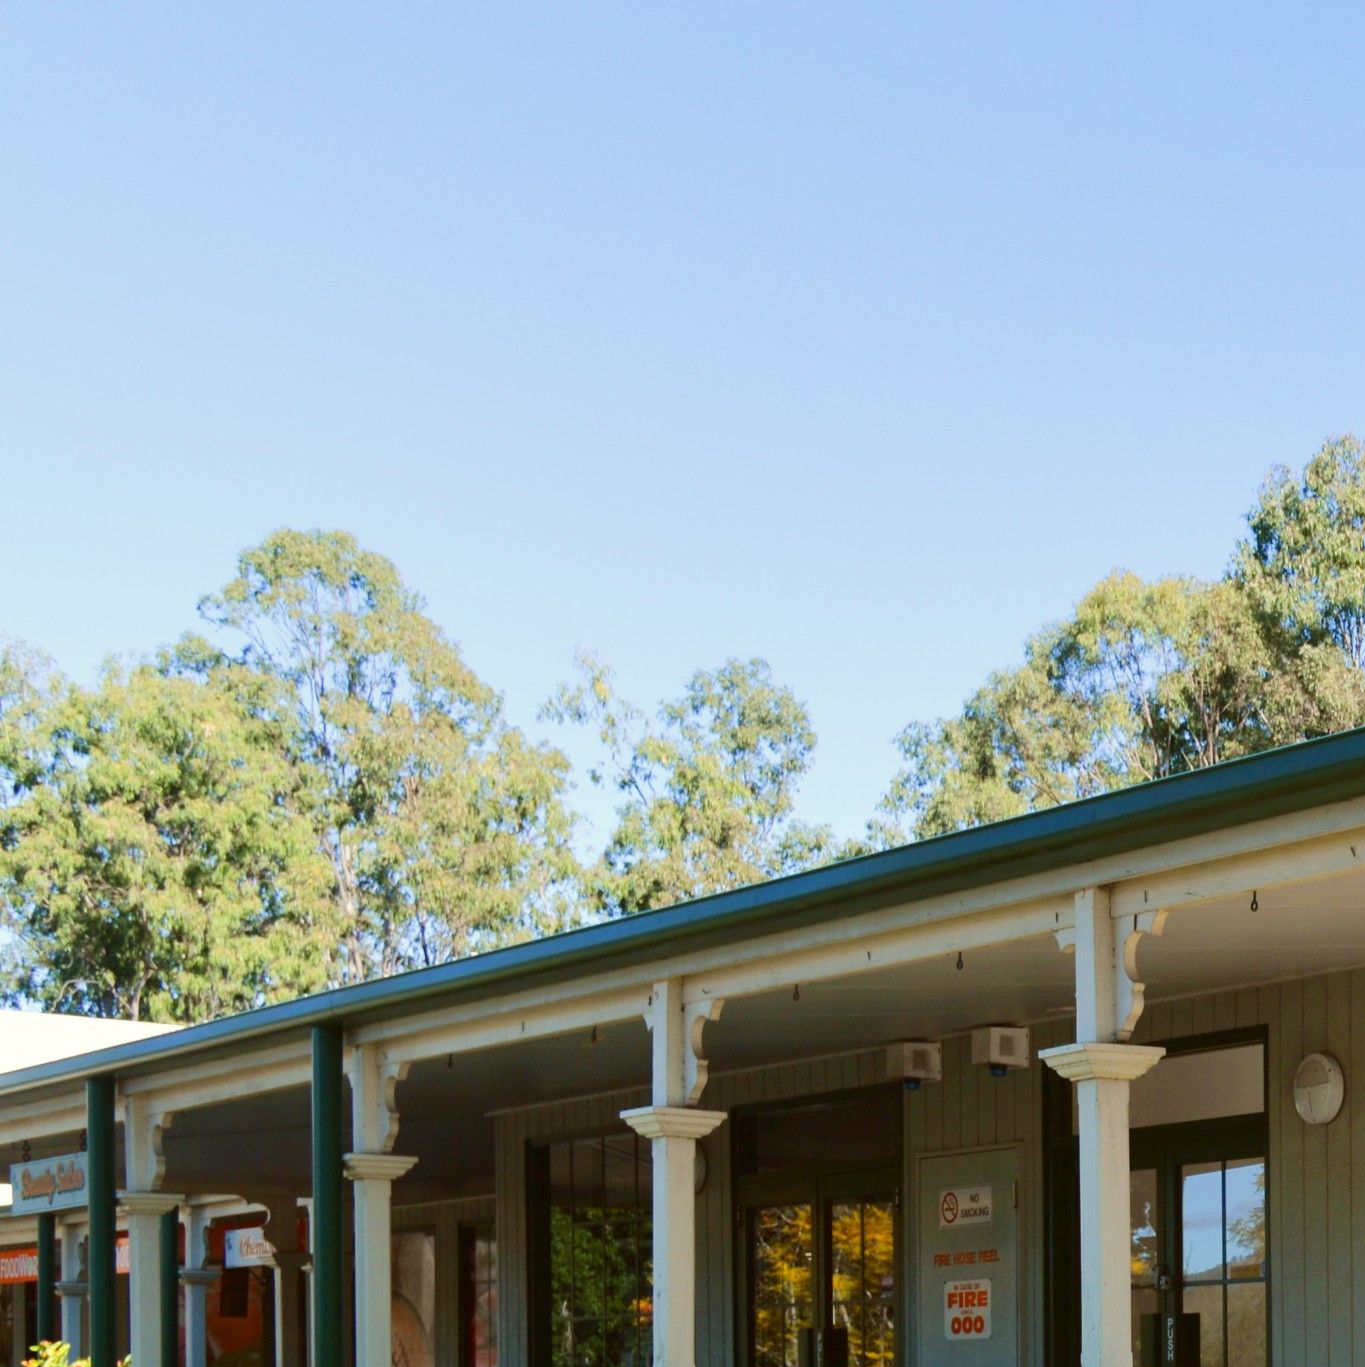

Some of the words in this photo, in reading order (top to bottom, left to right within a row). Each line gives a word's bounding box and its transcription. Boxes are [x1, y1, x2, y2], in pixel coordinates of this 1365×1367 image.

[970, 1193, 979, 1203] NO
[960, 1206, 989, 1218] SMOKING
[947, 1291, 988, 1308] FIRE
[951, 1316, 985, 1334] 000
